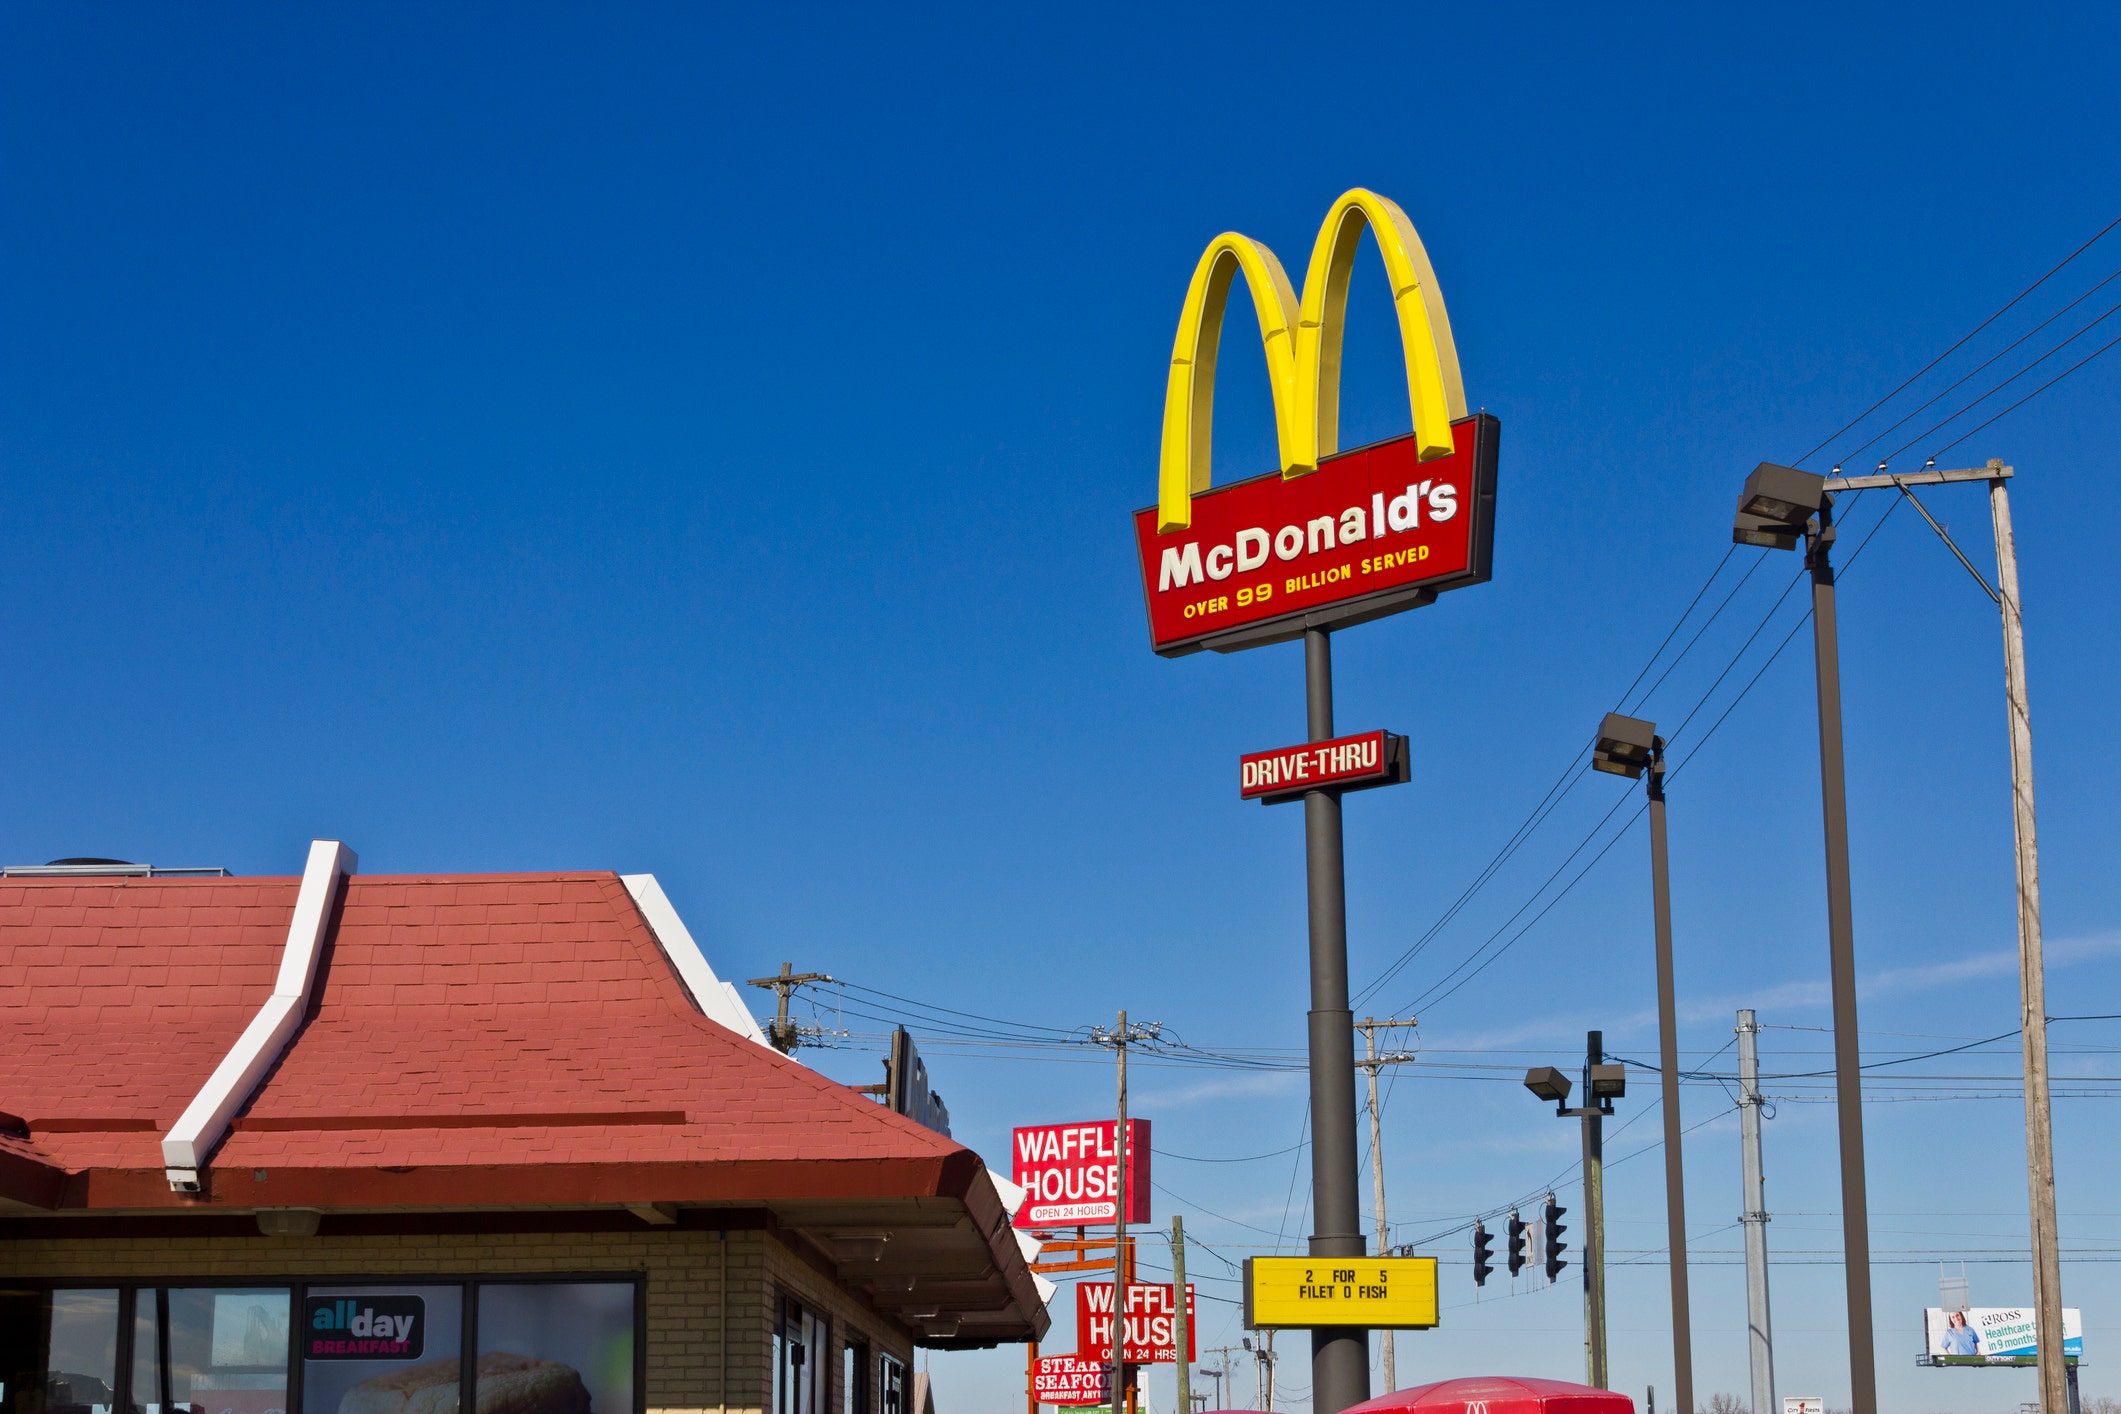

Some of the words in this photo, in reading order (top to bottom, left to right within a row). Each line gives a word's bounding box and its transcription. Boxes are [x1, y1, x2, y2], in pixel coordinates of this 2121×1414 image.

[1158, 478, 1458, 592] McDonald's
[1183, 596, 1229, 620] OVER
[1236, 583, 1273, 607] 99
[1286, 563, 1352, 594] BILLION
[1361, 545, 1430, 575] SERVED
[1242, 739, 1377, 789] DRIVE-THRU
[1021, 1165, 1118, 1201] HOUSE
[1035, 1207, 1060, 1218] OPEN
[1063, 1206, 1074, 1217] 24
[1077, 1204, 1110, 1216] HOURS
[1305, 1270, 1313, 1283] 2
[1332, 1270, 1356, 1283] FOR
[1379, 1270, 1388, 1283] 5
[1299, 1285, 1335, 1299] FILET
[1359, 1285, 1388, 1299] FISH
[312, 1300, 357, 1330] all
[351, 1308, 415, 1342] day
[1991, 1309, 2022, 1325] ROSS
[1984, 1323, 2031, 1339] Healthcare
[312, 1340, 411, 1354] BREAKFAST
[1987, 1341, 1997, 1351] in
[1997, 1340, 2004, 1349] 9
[2004, 1334, 2037, 1347] months
[1101, 1348, 1132, 1359] ON
[1136, 1349, 1149, 1359] 24
[1154, 1349, 1177, 1359] HRS
[1040, 1390, 1081, 1401] BREAKFAST
